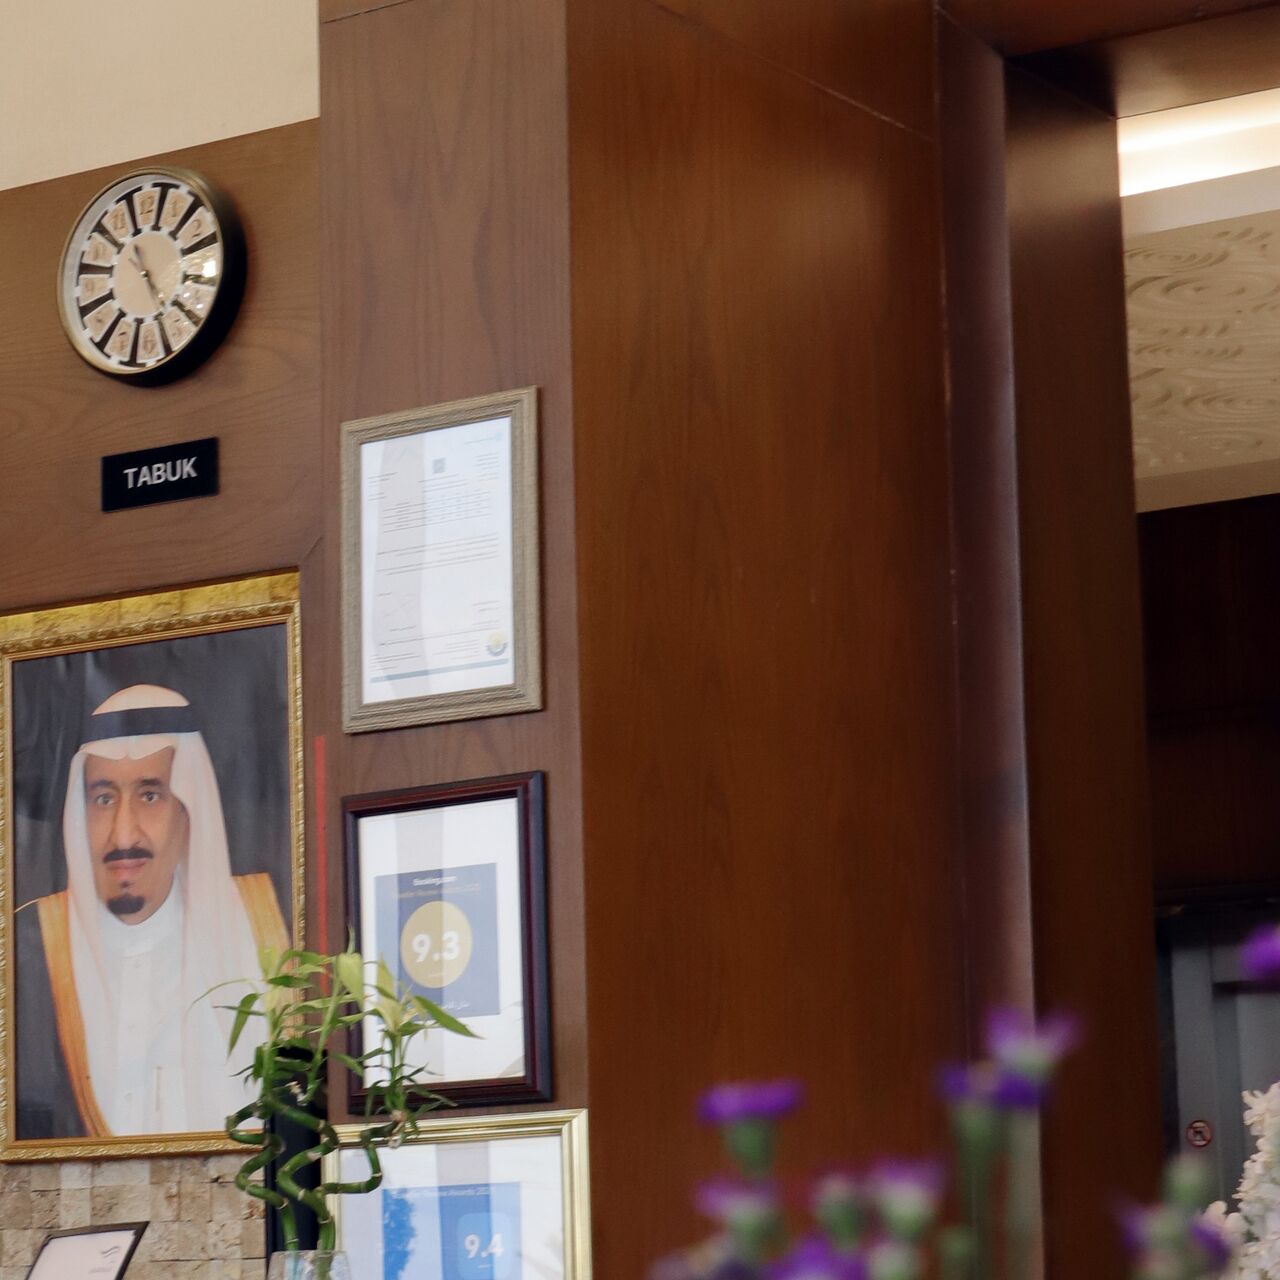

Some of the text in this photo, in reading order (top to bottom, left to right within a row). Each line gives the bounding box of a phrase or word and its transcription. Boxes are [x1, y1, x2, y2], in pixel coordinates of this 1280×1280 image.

[123, 456, 198, 490] TABUK
[411, 930, 461, 964] 9.3
[463, 1232, 505, 1259] 9.4
